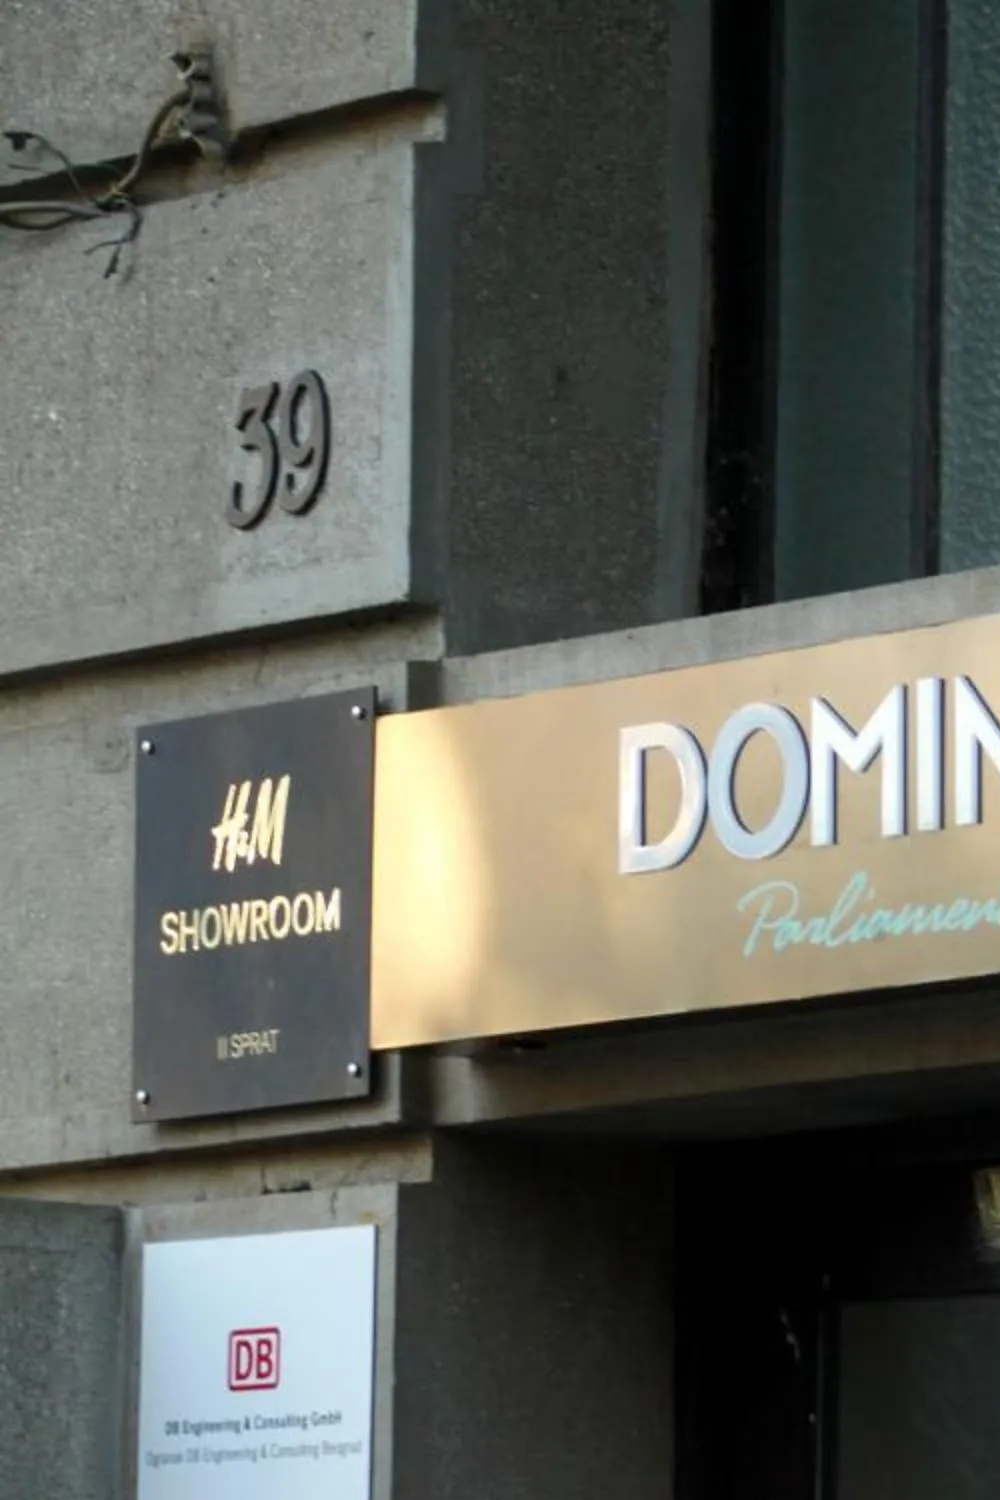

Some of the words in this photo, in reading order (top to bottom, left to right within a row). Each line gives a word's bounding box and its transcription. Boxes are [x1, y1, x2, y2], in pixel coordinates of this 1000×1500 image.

[226, 369, 332, 532] 39
[210, 773, 291, 873] H&M
[160, 887, 341, 955] SHOWROOM
[229, 1028, 281, 1059] SPRAT
[234, 1338, 274, 1382] DB
